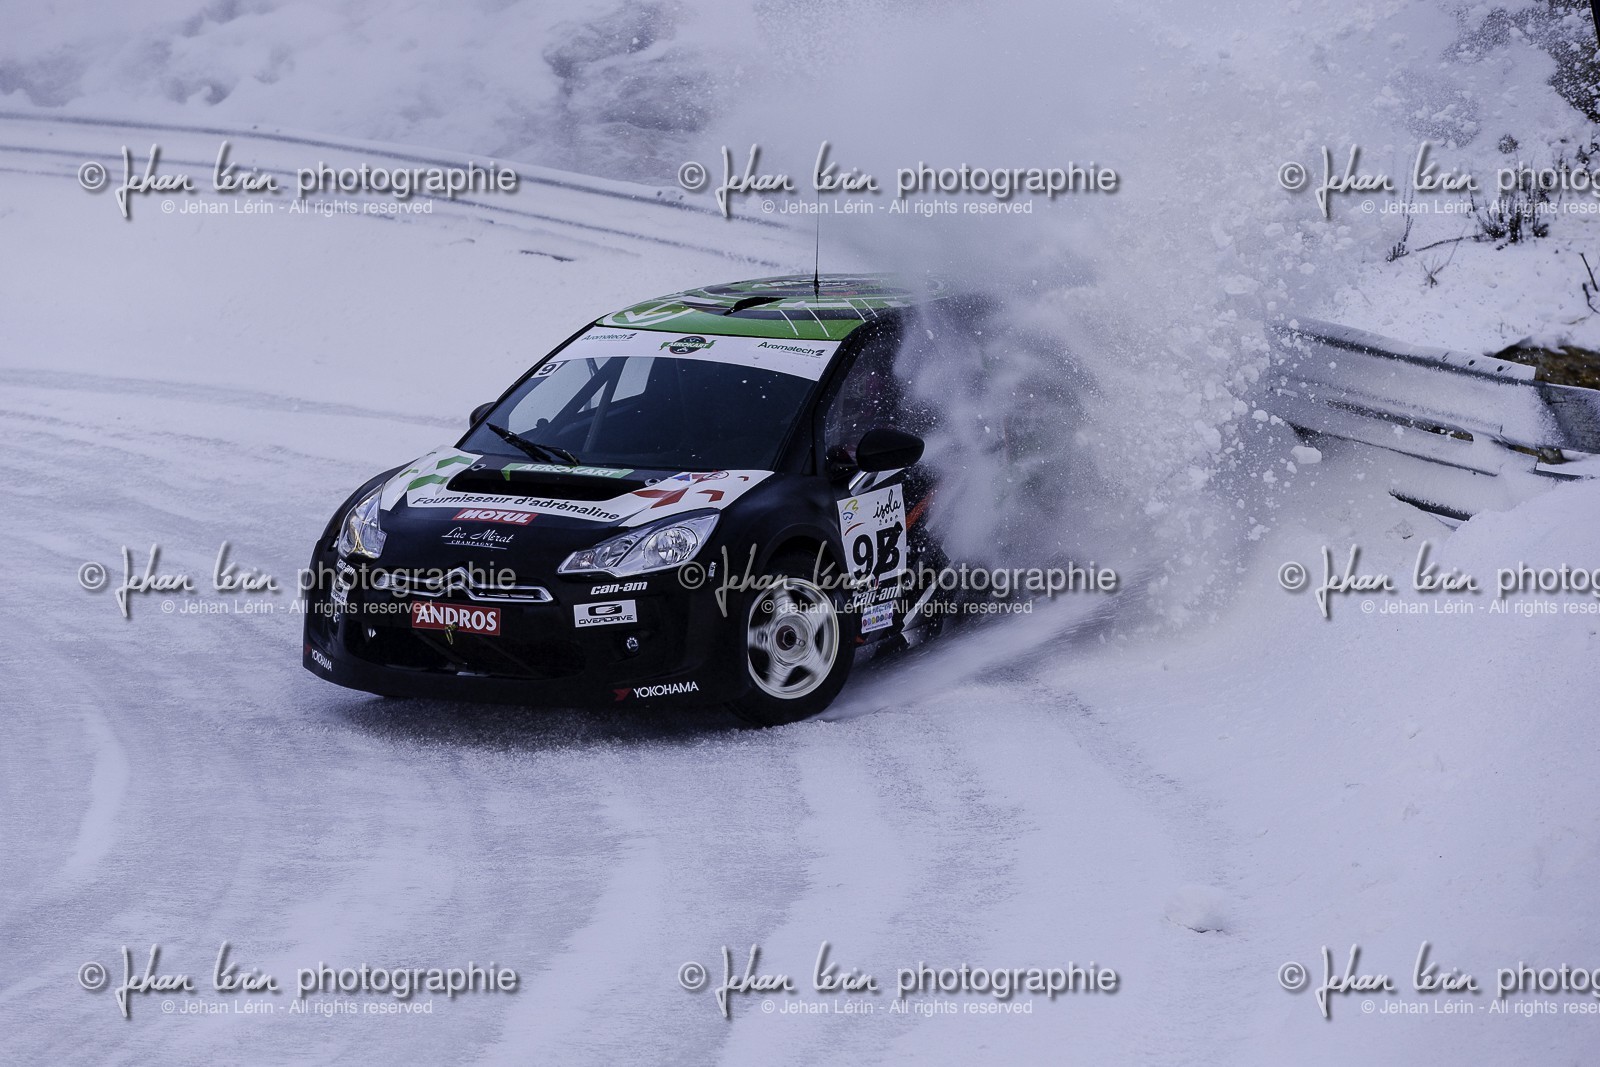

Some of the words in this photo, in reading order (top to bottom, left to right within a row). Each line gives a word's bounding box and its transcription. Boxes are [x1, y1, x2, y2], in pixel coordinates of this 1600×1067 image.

[757, 341, 815, 355] Aromatech
[520, 463, 620, 477] AEROKART
[411, 493, 512, 505] Fournisseur
[514, 496, 620, 520] d'adrénaline
[872, 488, 902, 519] isola
[458, 509, 532, 523] MOTUL
[441, 526, 467, 538] Luc
[451, 539, 494, 547] CHAMPAGNE
[590, 581, 648, 595] can-am
[852, 586, 899, 608] can-am
[415, 605, 497, 632] ANDROS
[578, 614, 634, 625] OVERDRIVE
[633, 680, 699, 698] YOKOHAMA
